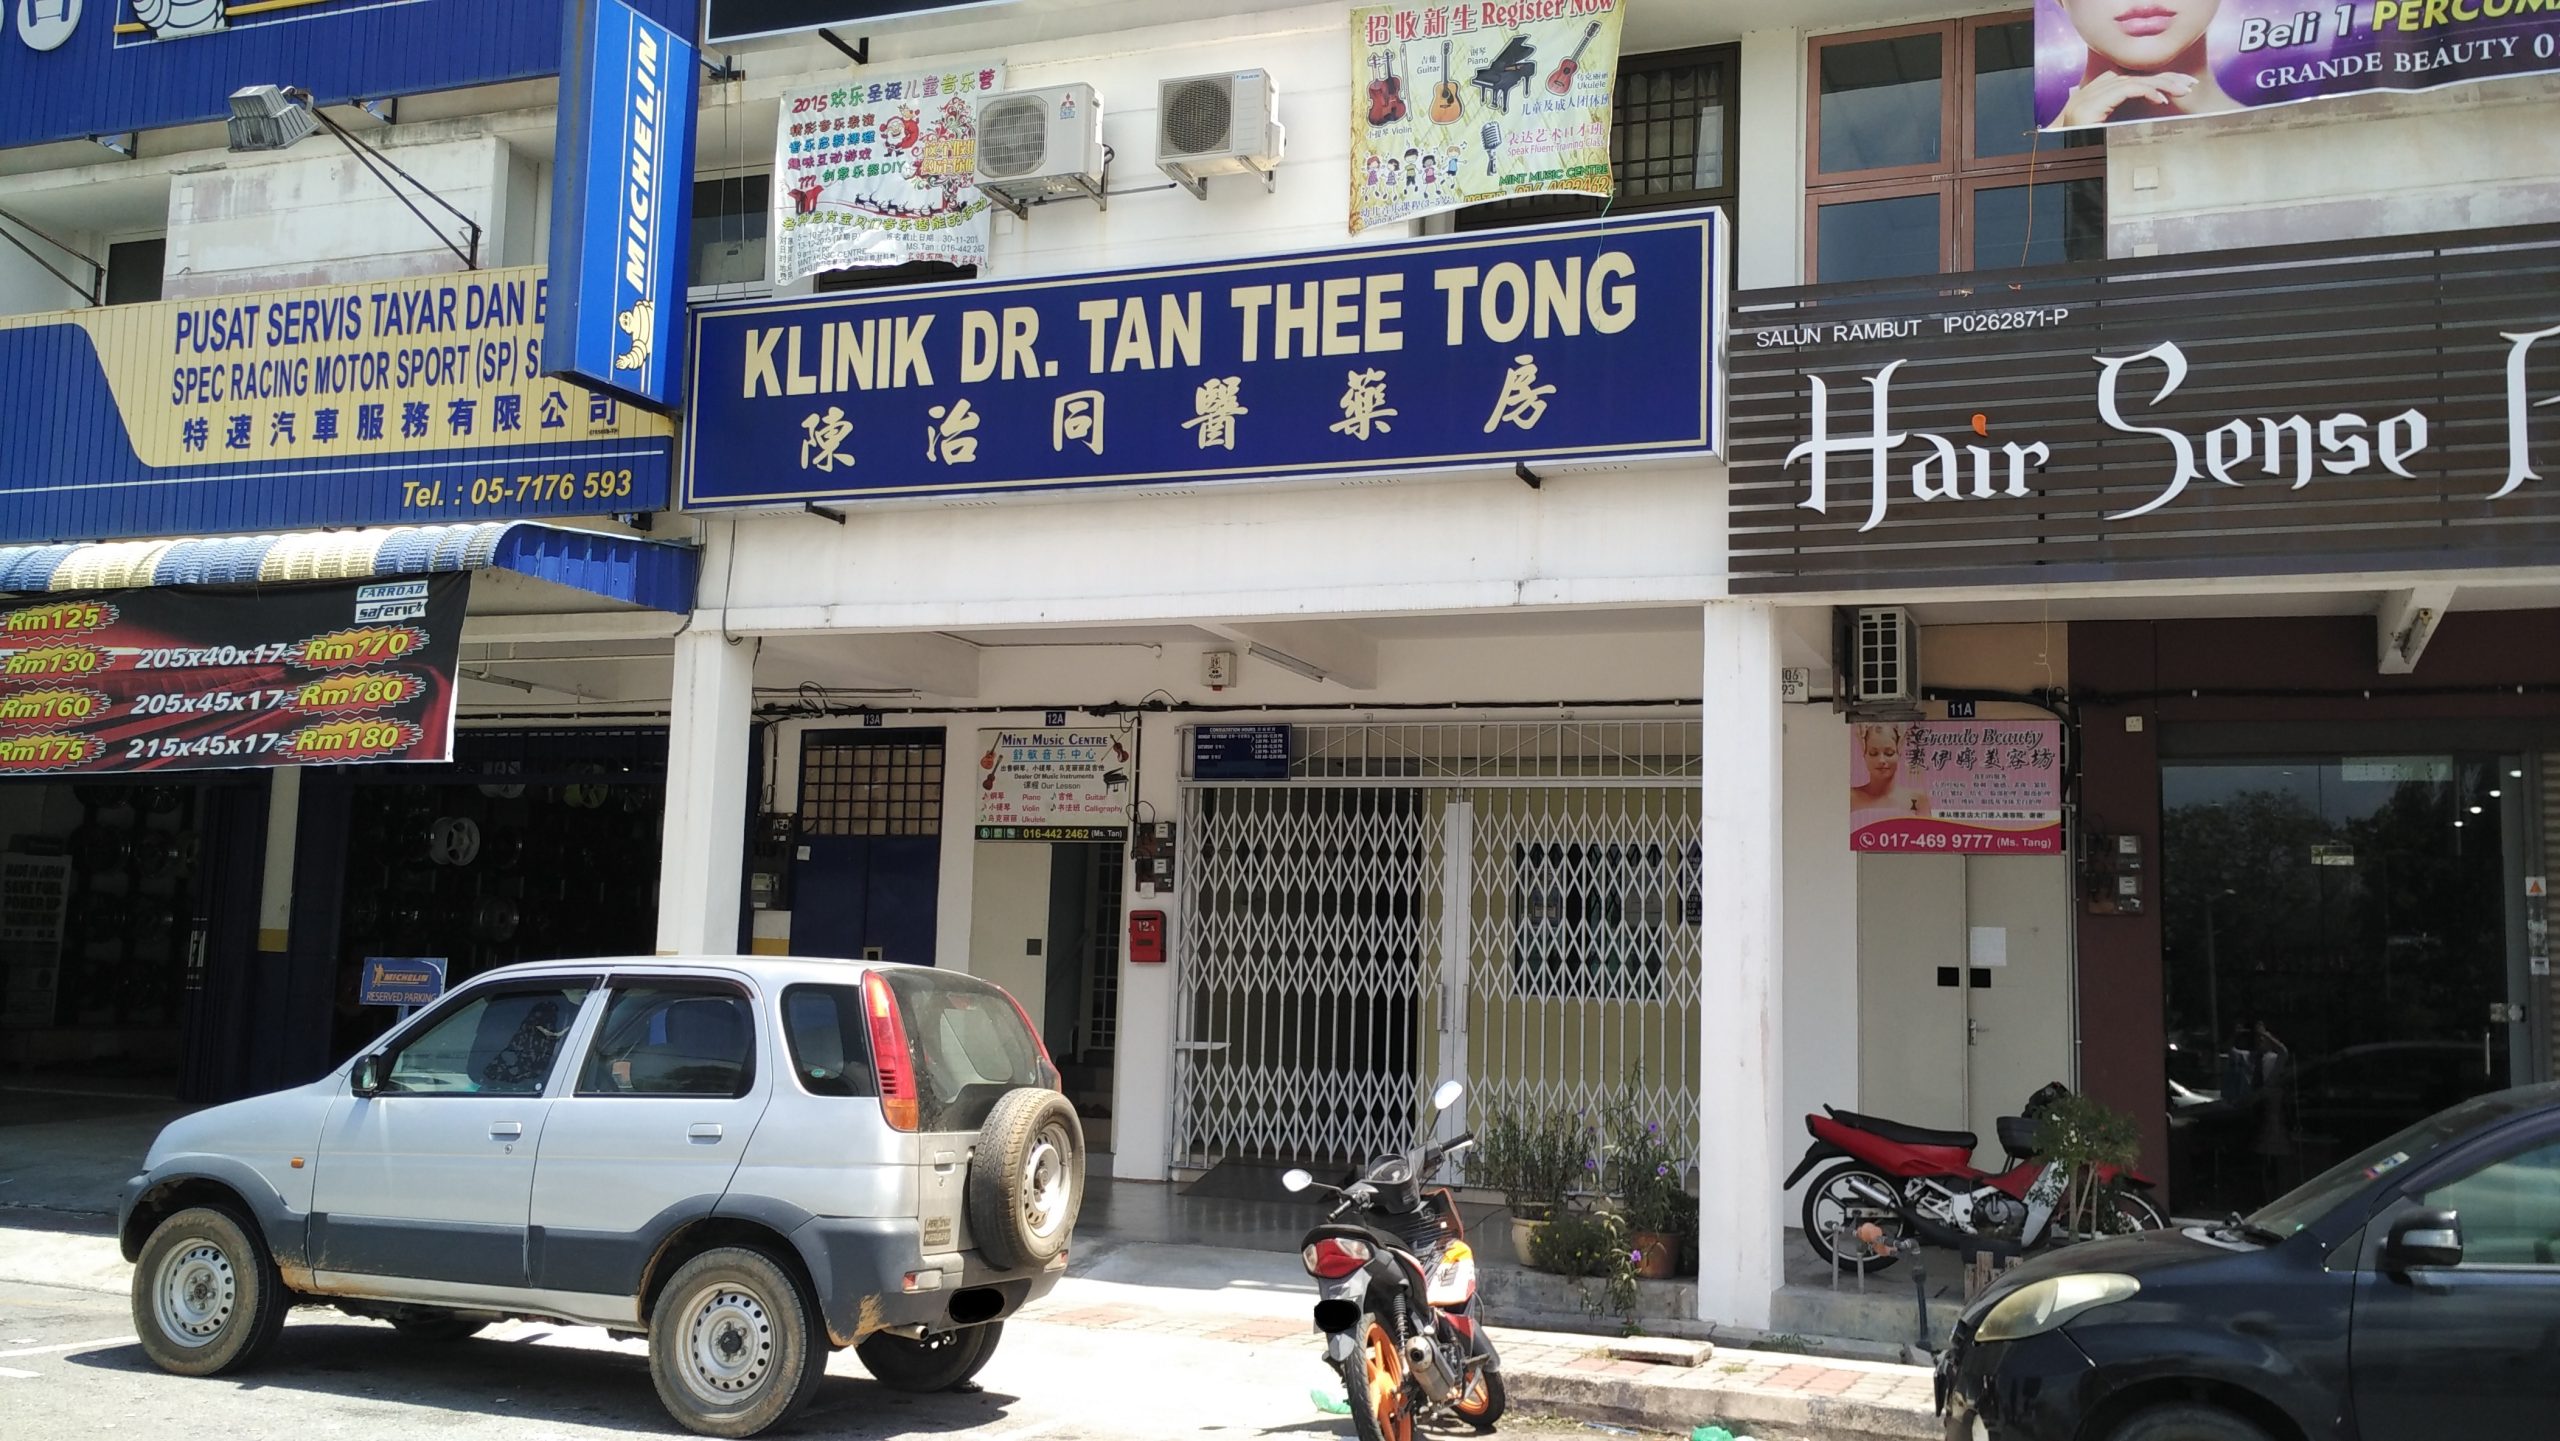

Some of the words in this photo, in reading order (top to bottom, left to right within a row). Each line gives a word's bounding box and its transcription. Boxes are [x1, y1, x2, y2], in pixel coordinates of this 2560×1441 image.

[1366, 7, 1477, 45] 招收新生
[1481, 0, 1567, 27] Register
[1569, 0, 1617, 16] Now
[2239, 11, 2319, 52] Beli
[2335, 4, 2353, 37] 1
[1416, 65, 1440, 75] Guitar
[1467, 57, 1489, 65] Piano
[2255, 52, 2383, 89] GRANDE
[2394, 36, 2519, 72] BEAUTY
[1577, 81, 1606, 90] Ukulele
[1391, 126, 1412, 135] Violin
[625, 26, 658, 295] MICHELIN
[1507, 148, 1529, 157] Speak
[1531, 144, 1554, 154] Fluent
[1500, 173, 1527, 185] MINT
[1529, 169, 1563, 182] MUSIC
[1566, 164, 1609, 178] CENTRE
[175, 305, 260, 354] PUSAT
[266, 295, 362, 347] SERVIS
[371, 287, 457, 336] TAYAR
[466, 280, 526, 330] DAN
[743, 314, 937, 398] KLINIK
[960, 306, 1059, 384] DR.
[1079, 291, 1202, 374] TAN
[1230, 272, 1405, 363] THEE
[1434, 251, 1637, 347] TONG
[1756, 328, 1822, 348] SALUN
[1833, 319, 1923, 342] RAMBUT
[1943, 308, 2070, 334] IP0262871-P
[172, 364, 225, 406] SPEC
[230, 357, 308, 401] RACING
[314, 351, 390, 395] MOTOR
[396, 345, 470, 389] SPORT
[475, 336, 518, 388] (SP)
[182, 390, 618, 452] 特速汽車服務有限公司
[800, 353, 1557, 474] 陳治同醫藥房
[1783, 358, 2050, 532] Hair
[2092, 340, 2429, 521] Sense
[402, 480, 444, 508] Tel.
[471, 472, 576, 505] 05-7176
[583, 469, 632, 499] 593
[360, 583, 426, 598] FARROAD
[7, 608, 101, 631] Rm125
[134, 643, 288, 669] 205x40x17
[304, 633, 410, 661] Rm170
[4, 652, 97, 674] Rm130
[0, 697, 91, 718] Rm160
[130, 689, 285, 715] 205x45x17
[299, 680, 404, 706] Rm180
[865, 714, 881, 725] 13A
[1047, 713, 1064, 725] 12A
[1950, 703, 1973, 716] 11A
[125, 733, 280, 759] 215x45x17
[295, 726, 399, 752] Rm180
[1914, 728, 1978, 746] Grande
[1980, 728, 2044, 748] Beauty
[0, 740, 86, 761] Rm175
[1041, 782, 1054, 790] Our
[1056, 781, 1081, 790] Lesson
[1085, 793, 1106, 801] Guitar
[1022, 804, 1040, 812] Violin
[1085, 805, 1122, 814] Calligraphy
[1023, 828, 1062, 839] 016-442
[1065, 828, 1089, 839] 2462
[1091, 830, 1106, 838] (Ms.
[1107, 830, 1122, 839] Tan)
[1879, 833, 1947, 848] 017-469
[1951, 834, 1994, 849] 9777
[1996, 837, 2019, 848] (Ms.
[2021, 837, 2052, 849] Tang)
[384, 973, 430, 982] MICHELIN
[366, 992, 403, 1001] RESERVED
[405, 993, 437, 1002] PARKING
